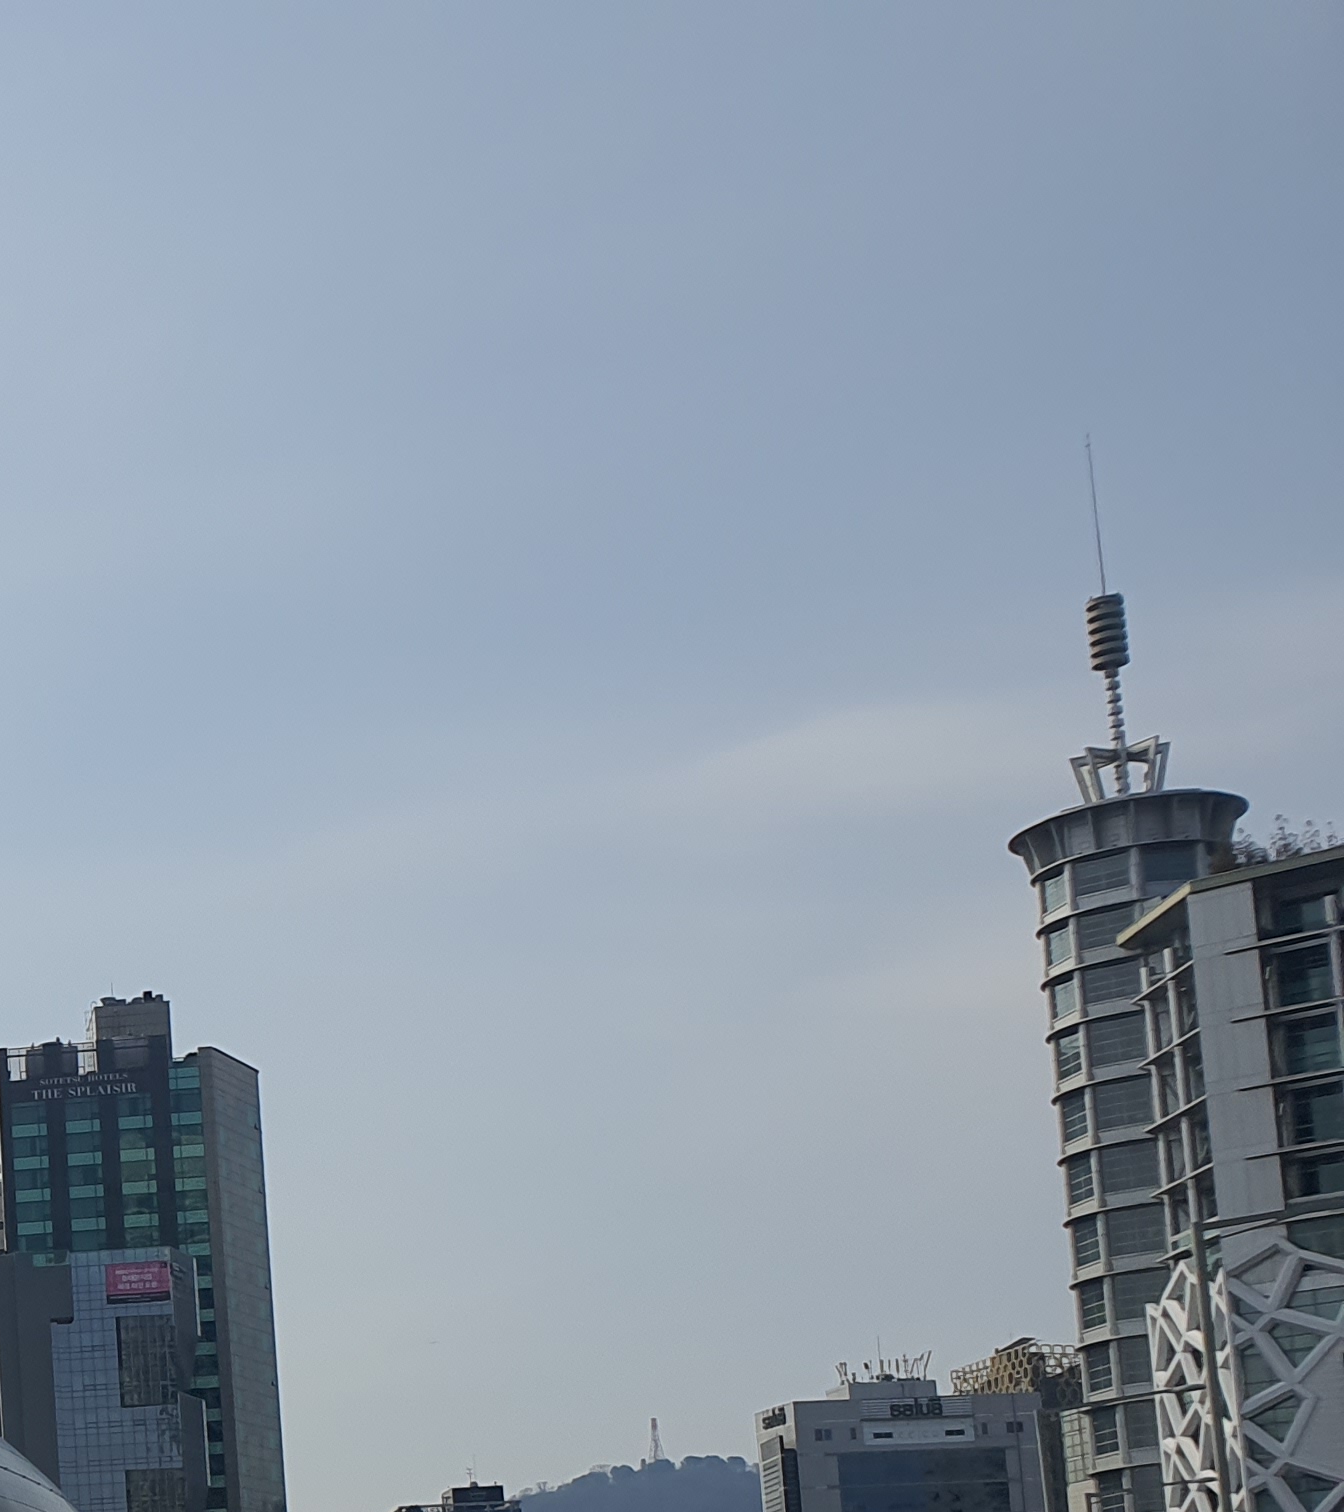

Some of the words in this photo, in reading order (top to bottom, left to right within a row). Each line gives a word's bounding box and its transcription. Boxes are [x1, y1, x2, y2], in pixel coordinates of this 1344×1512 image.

[88, 1073, 128, 1082] HOTELS
[32, 1088, 63, 1100] THE
[68, 1083, 137, 1097] SPLAISIR
